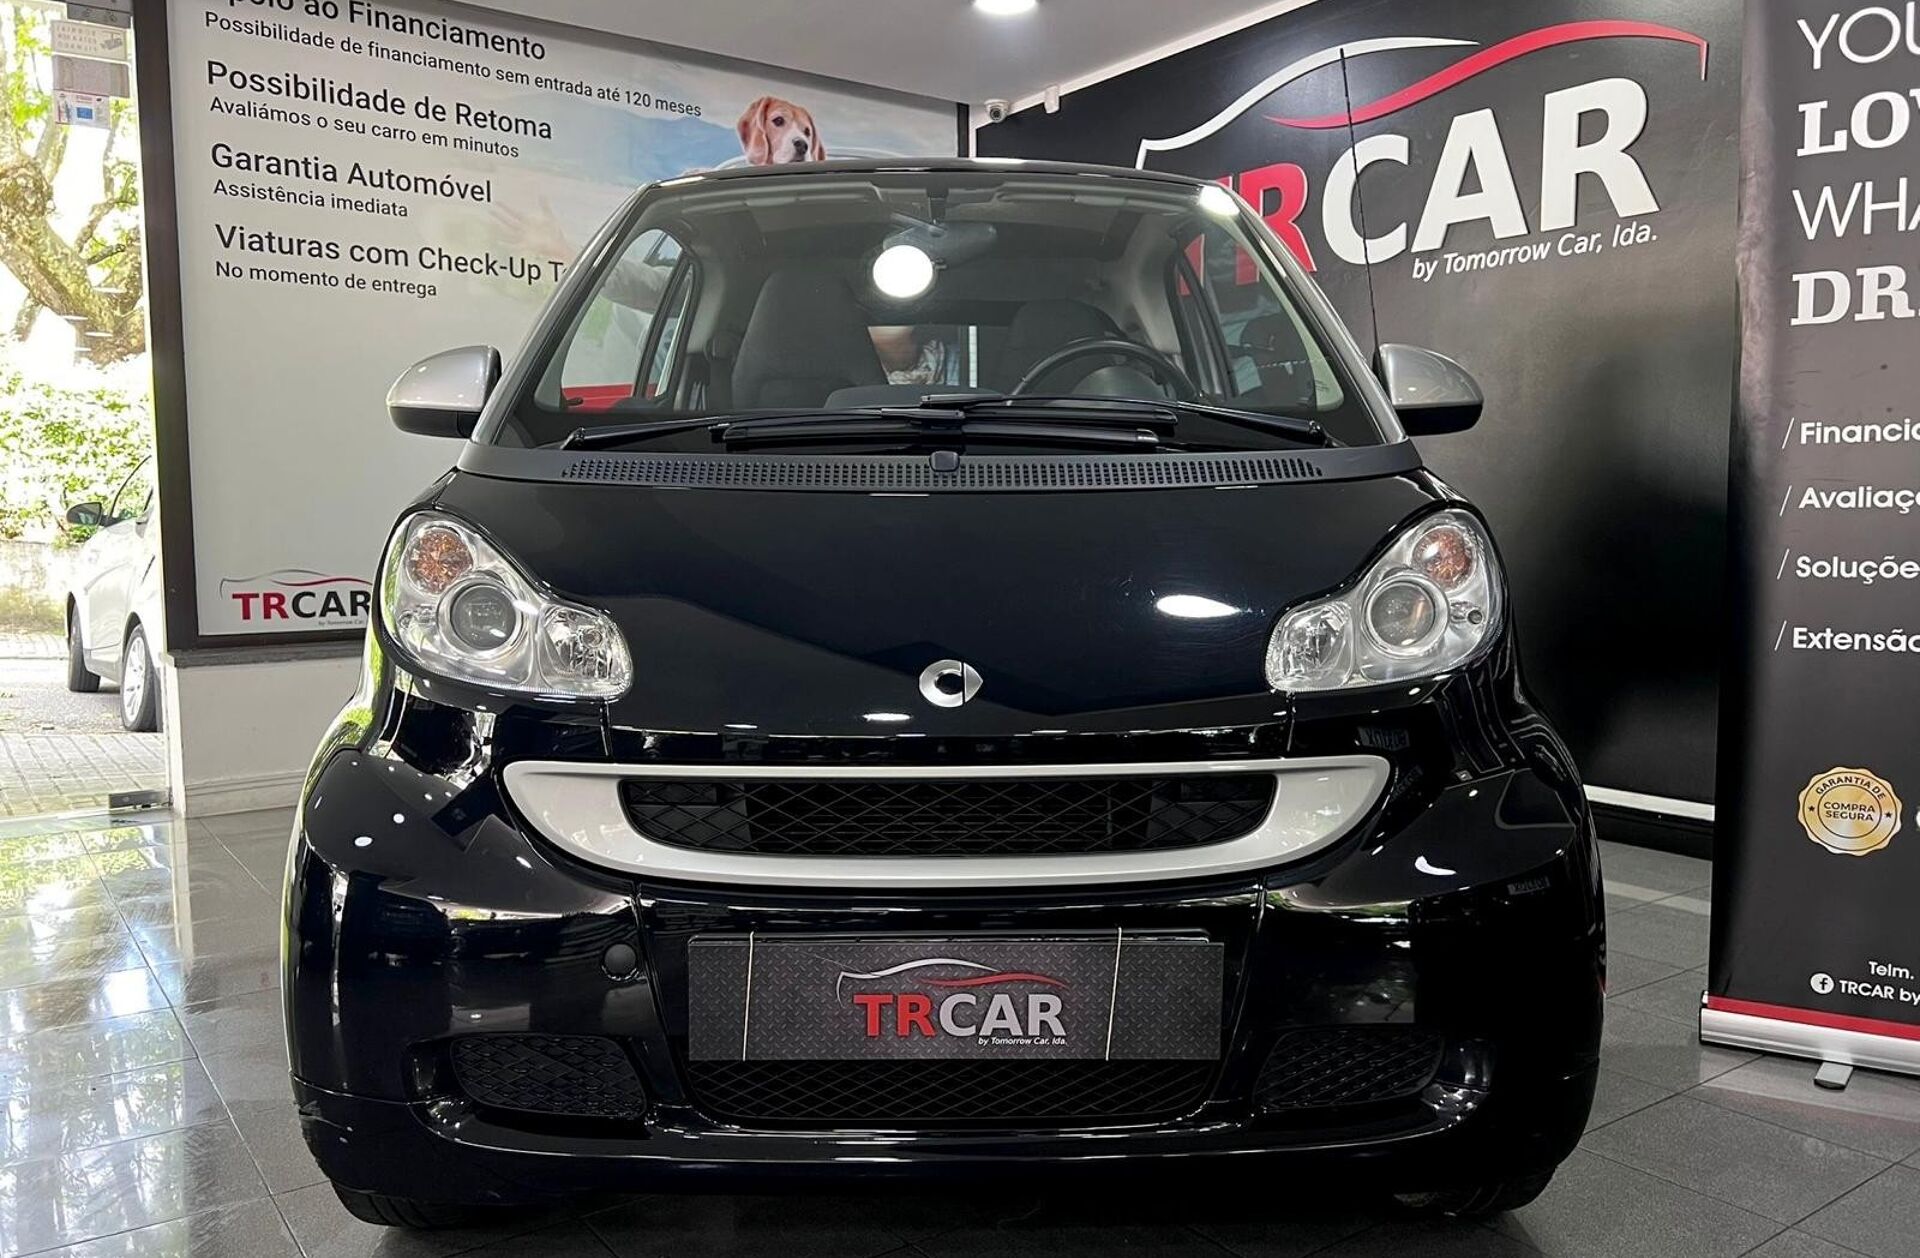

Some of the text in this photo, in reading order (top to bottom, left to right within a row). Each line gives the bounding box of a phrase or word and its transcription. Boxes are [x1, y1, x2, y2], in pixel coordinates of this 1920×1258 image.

[304, 0, 545, 60] ao Financiamento
[205, 11, 702, 117] Possibilidade de financiamento sem entrada até 120 meses
[207, 60, 552, 139] Possibilidade de Retoma
[210, 97, 519, 158] Avaliámos o seu carro em minutos
[1796, 88, 1920, 157] LO
[211, 143, 491, 202] Garantia Automóvel
[213, 179, 408, 217] Assistência imediata
[1792, 177, 1920, 240] WH
[215, 224, 567, 285] Viaturas com Check-Up T
[1412, 258, 1438, 282] by
[1443, 241, 1551, 274] Tomorrow
[1557, 232, 1602, 257] Car,
[216, 261, 437, 298] No momento de entrega
[1790, 265, 1920, 325] DR
[1799, 486, 1920, 514] Avaliaç
[232, 590, 371, 620] TRCAR
[1815, 776, 1886, 800] GARANTIA DE
[1823, 801, 1876, 813] COMPRA
[1825, 810, 1874, 821] SEGURA
[1868, 960, 1915, 980] Telm.
[853, 993, 1067, 1037] TRCAR
[1839, 980, 1920, 1006] TRCAR by
[978, 1037, 989, 1046] by
[991, 1037, 1032, 1045] Tomorrow
